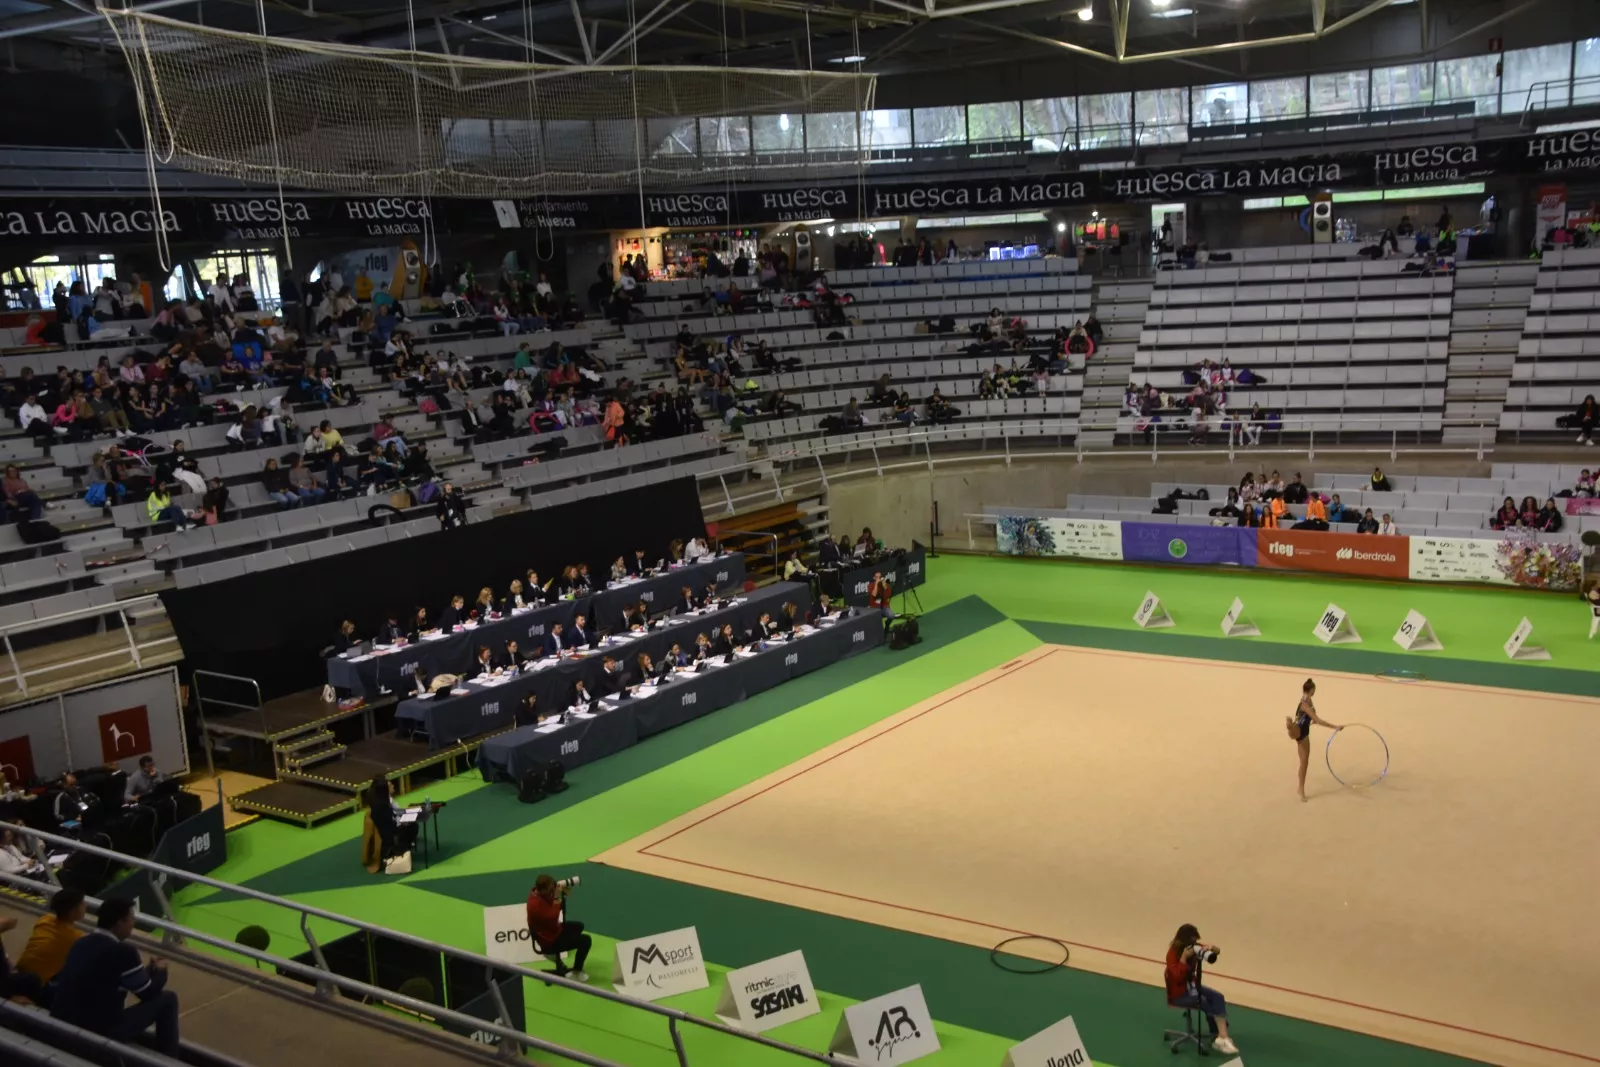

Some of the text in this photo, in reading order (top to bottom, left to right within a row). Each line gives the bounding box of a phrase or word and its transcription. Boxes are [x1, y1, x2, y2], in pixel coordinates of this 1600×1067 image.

[1269, 541, 1294, 558] rfeg
[1354, 549, 1396, 562] Iberdrola
[560, 739, 579, 756] rfeg
[186, 831, 211, 859] rfeg
[750, 983, 805, 1019] SASAKI
